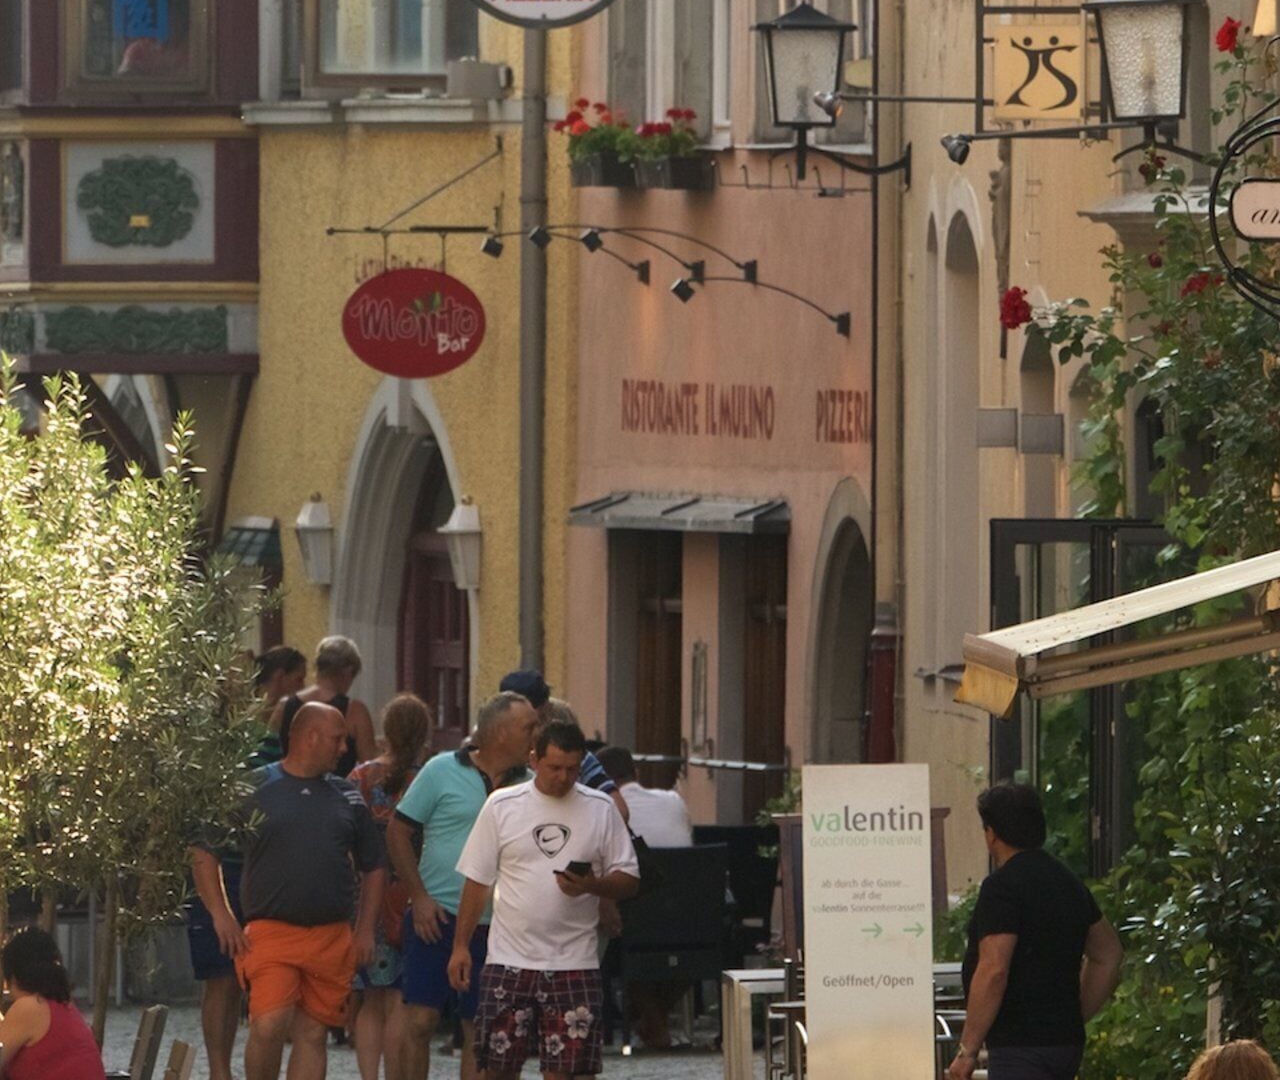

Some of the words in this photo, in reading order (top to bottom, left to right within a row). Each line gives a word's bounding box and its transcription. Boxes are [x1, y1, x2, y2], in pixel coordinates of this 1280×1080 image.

[436, 332, 470, 355] Bar
[622, 378, 699, 436] RISTORANTE
[719, 384, 776, 441] MULINO
[815, 388, 872, 444] PIZZERI
[811, 804, 924, 832] valentin
[834, 878, 859, 888] durch
[822, 974, 915, 990] Geöffnet/Open
